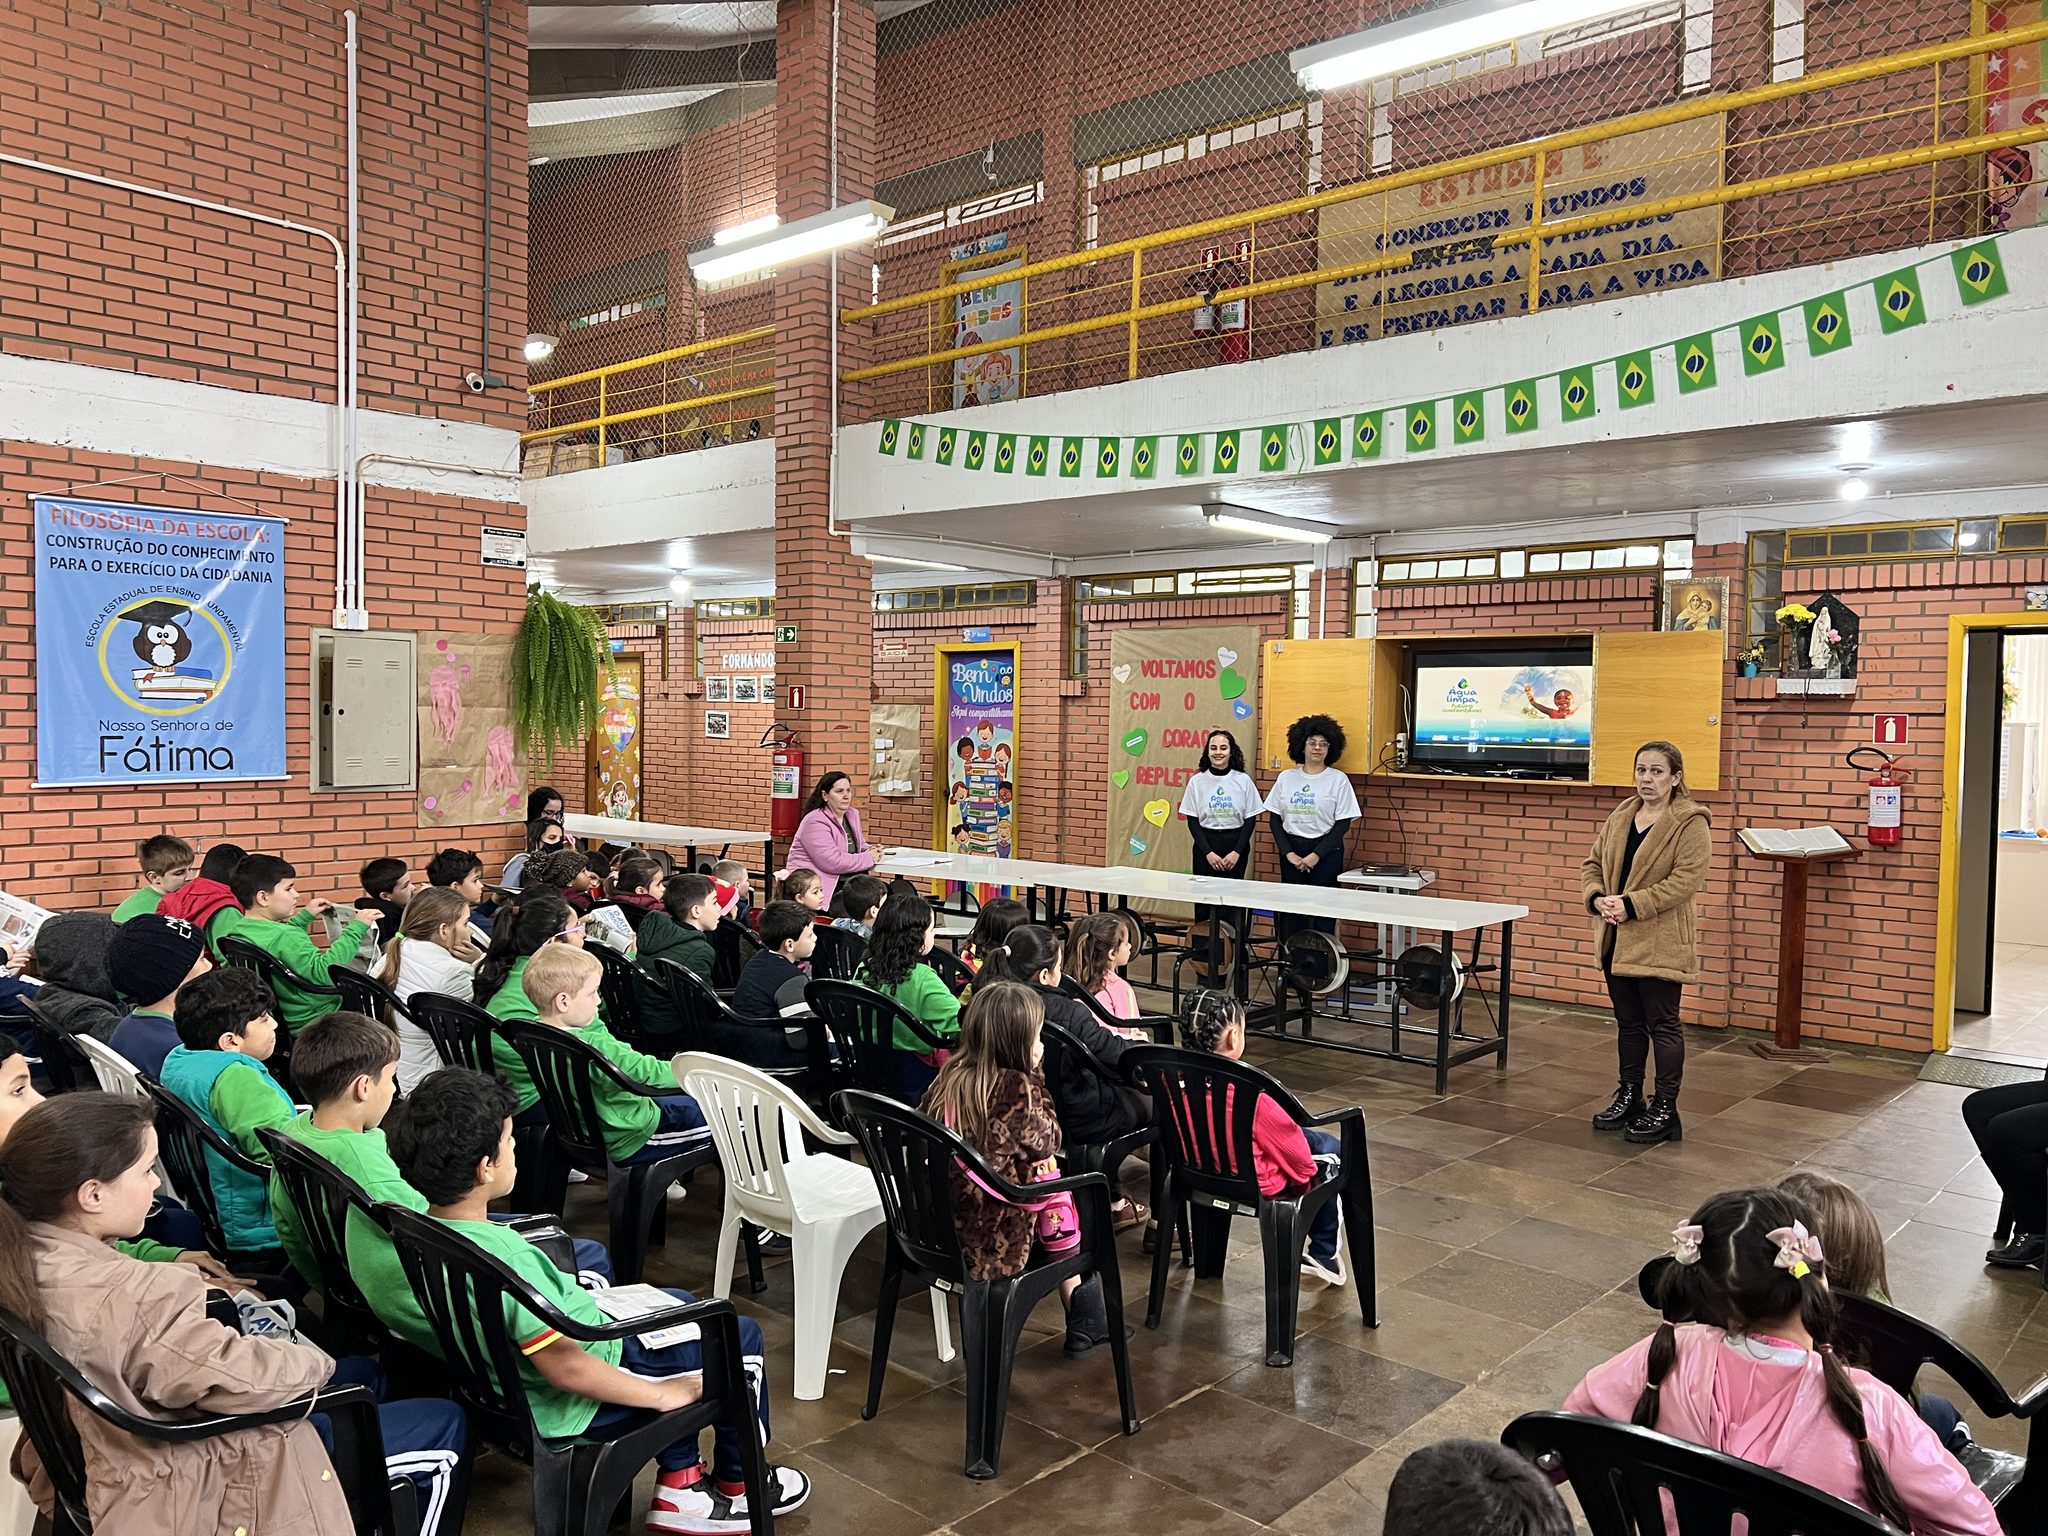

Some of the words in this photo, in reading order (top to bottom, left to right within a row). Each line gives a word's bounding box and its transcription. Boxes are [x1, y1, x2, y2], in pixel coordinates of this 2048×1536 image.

[1375, 208, 1511, 250] CONHECER
[1371, 270, 1494, 307] ALEGRIAS
[1502, 264, 1521, 283] A
[1603, 275, 1624, 295] A
[1634, 259, 1710, 289] VIDA
[51, 508, 155, 533] FILOSOFIA
[162, 519, 190, 536] DA
[195, 523, 271, 543] ESCOLA:
[46, 534, 143, 555] CONSTRUÇÃO
[147, 542, 168, 556] DO
[172, 544, 275, 564] CONHECIMENTO
[50, 556, 87, 571] PARA
[91, 559, 102, 572] O
[107, 560, 177, 578] EXERCÍCIO
[180, 566, 199, 579] DA
[202, 567, 273, 583] CIDADANIA
[86, 613, 106, 648] ESCOLA
[103, 587, 149, 614] ESTADUAL
[149, 585, 164, 593] DE
[166, 585, 201, 601] ENSINO
[203, 597, 244, 653] UNDAMENTAL
[722, 651, 776, 670] FORMANDO
[952, 662, 993, 683] Bem
[1140, 659, 1217, 679] VOLTAMOS
[963, 682, 1014, 703] Vindos
[1130, 691, 1161, 711] COM
[1184, 692, 1196, 711] O
[99, 719, 145, 732] Nossa
[150, 719, 210, 732] Senhora
[215, 719, 234, 731] de
[99, 735, 234, 773] Fátima
[1136, 766, 1201, 788] REPLET
